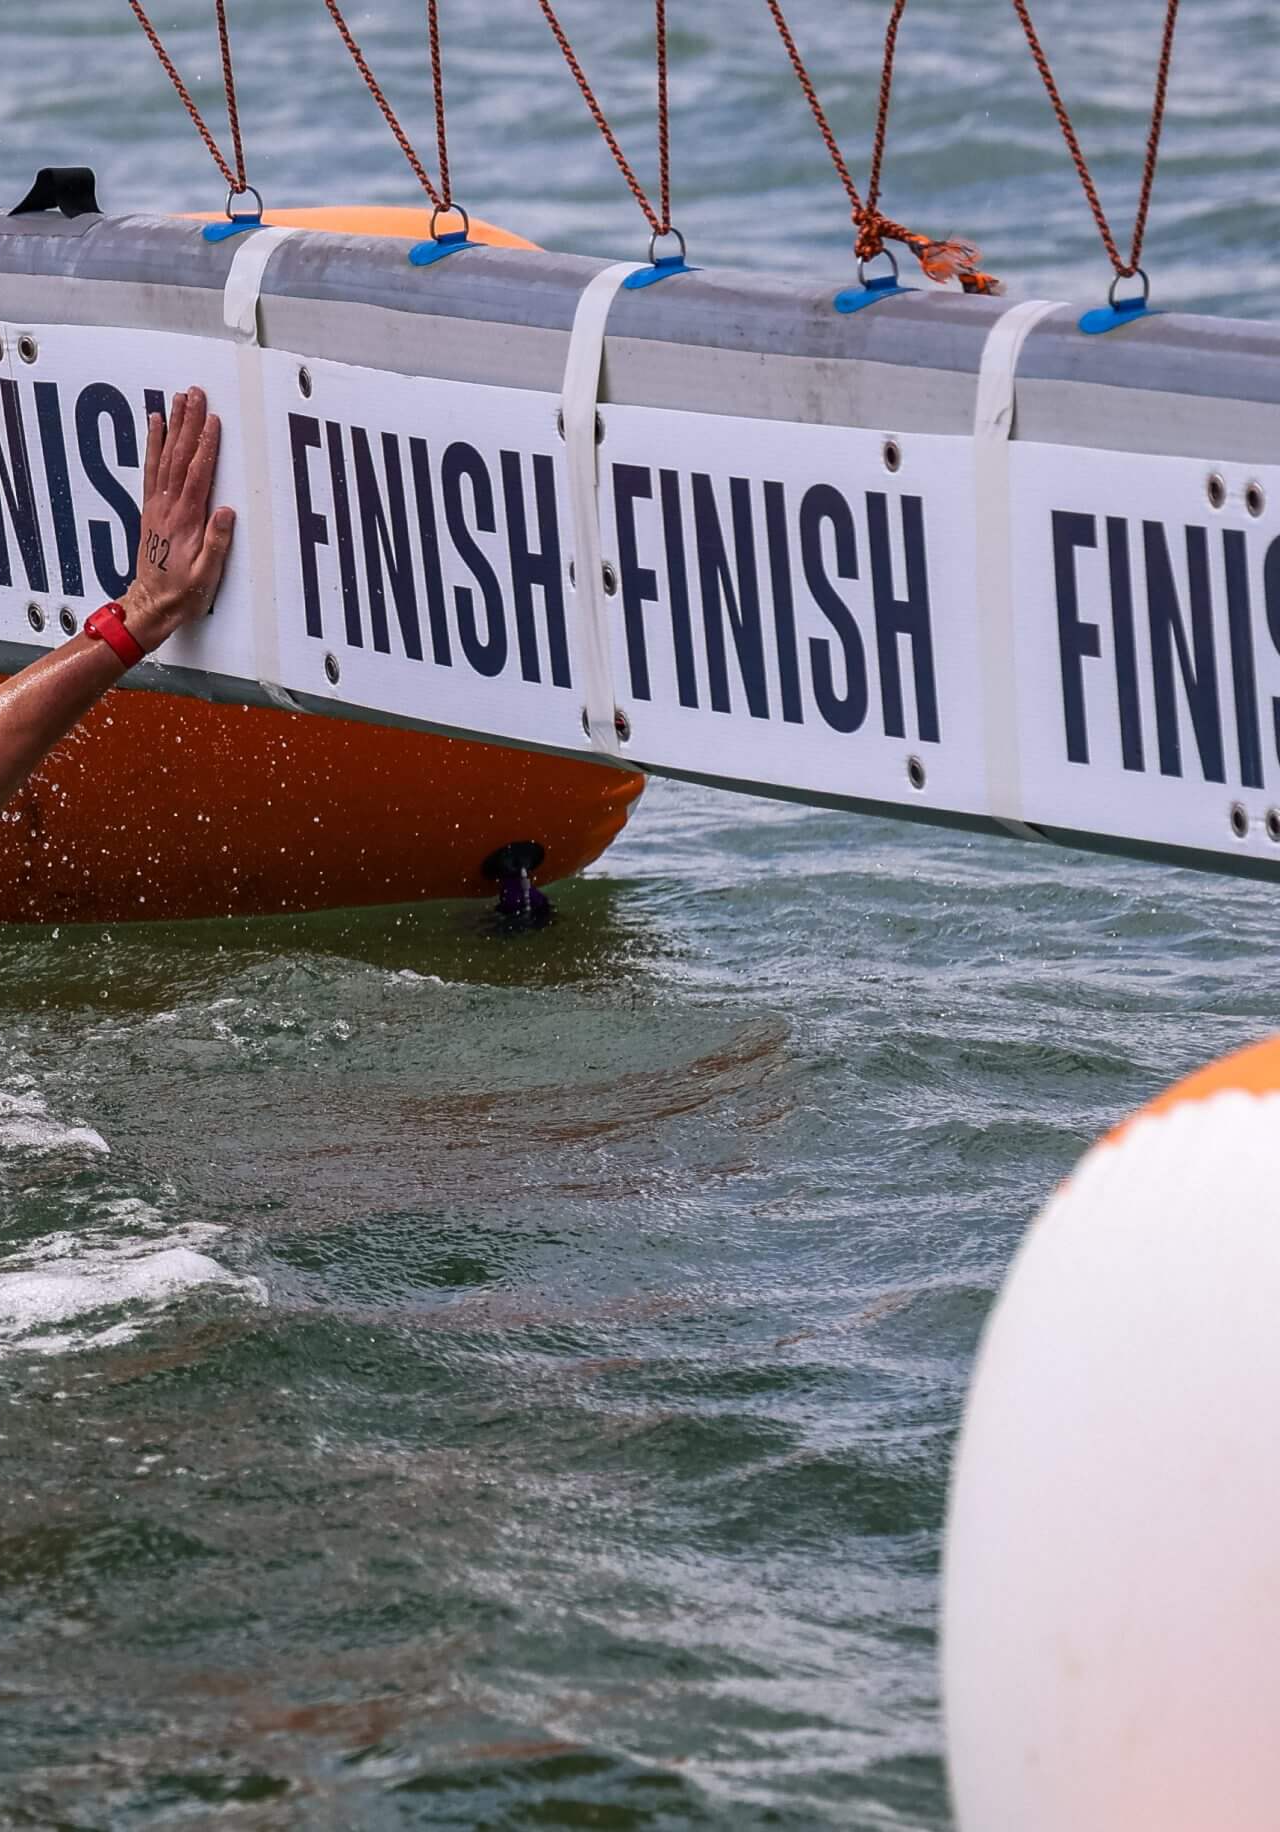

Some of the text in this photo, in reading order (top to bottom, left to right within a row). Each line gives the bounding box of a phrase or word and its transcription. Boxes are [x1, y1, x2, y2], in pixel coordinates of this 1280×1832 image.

[144, 528, 170, 573] 182
[287, 412, 573, 690] FINISH
[611, 462, 941, 744] FINISH
[1051, 510, 1280, 790] FINI
